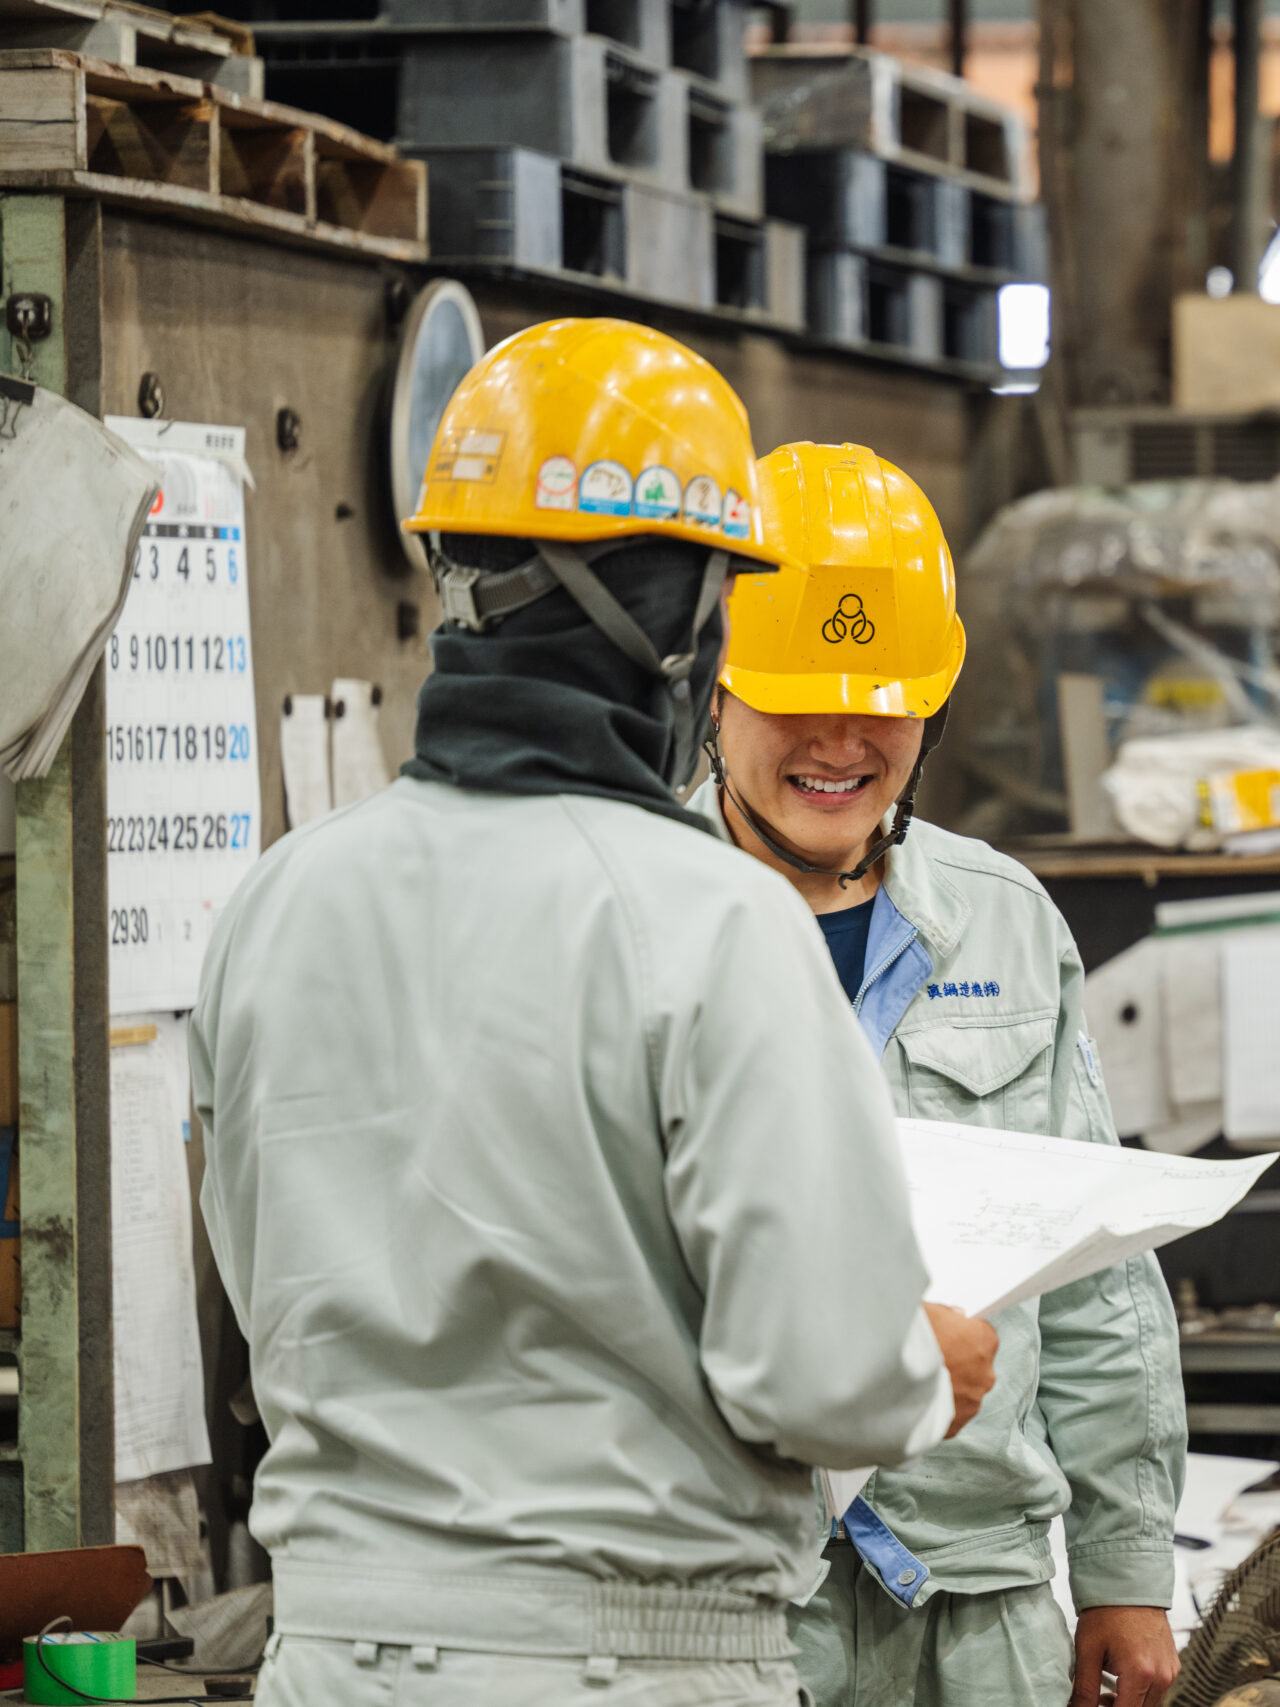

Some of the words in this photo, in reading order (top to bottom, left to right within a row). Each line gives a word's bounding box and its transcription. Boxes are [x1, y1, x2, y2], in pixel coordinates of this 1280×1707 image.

[150, 545, 159, 581] 3
[177, 546, 190, 582] 4
[206, 548, 216, 582] 5
[228, 548, 239, 583] 6
[111, 635, 119, 670] 8
[130, 635, 139, 670] 9
[145, 636, 167, 671] 10
[172, 636, 194, 670] 11
[203, 637, 225, 671] 12
[227, 637, 247, 672] 13
[107, 725, 124, 761] 15
[127, 725, 144, 761] 16
[147, 726, 167, 761] 17
[172, 726, 197, 760] 18
[204, 725, 226, 760] 19
[229, 725, 250, 760] 20
[107, 817, 125, 852] 22
[127, 817, 145, 851] 23
[148, 816, 169, 851] 24
[173, 815, 198, 850] 25
[203, 814, 227, 849] 26
[230, 814, 250, 849] 27
[111, 909, 129, 945] 29
[131, 907, 149, 943] 30
